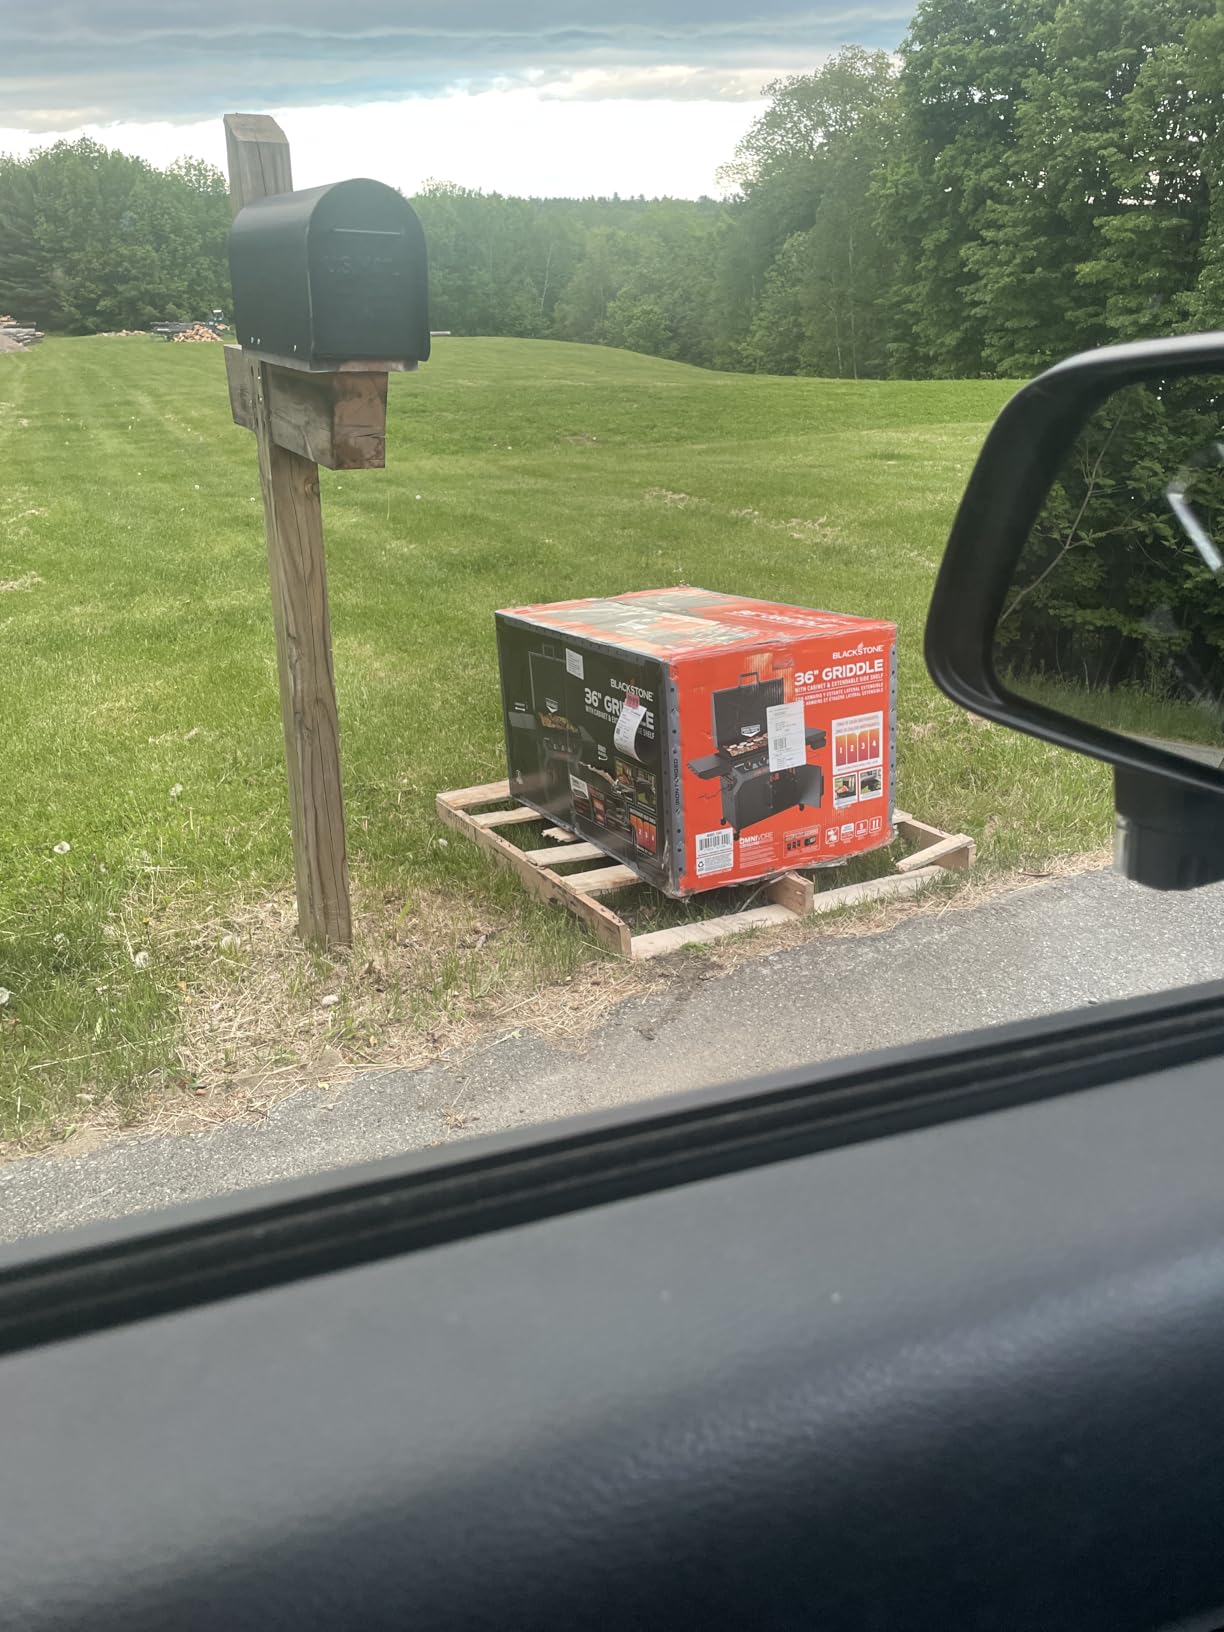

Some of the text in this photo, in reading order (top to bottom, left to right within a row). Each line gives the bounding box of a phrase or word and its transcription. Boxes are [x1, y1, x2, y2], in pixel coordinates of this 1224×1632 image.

[832, 644, 884, 660] BLACKSTONE
[794, 659, 884, 686] 36" GRIDDLE
[610, 678, 655, 702] BLACKSTONE
[584, 687, 602, 707] 36"
[603, 695, 655, 730] GRIE
